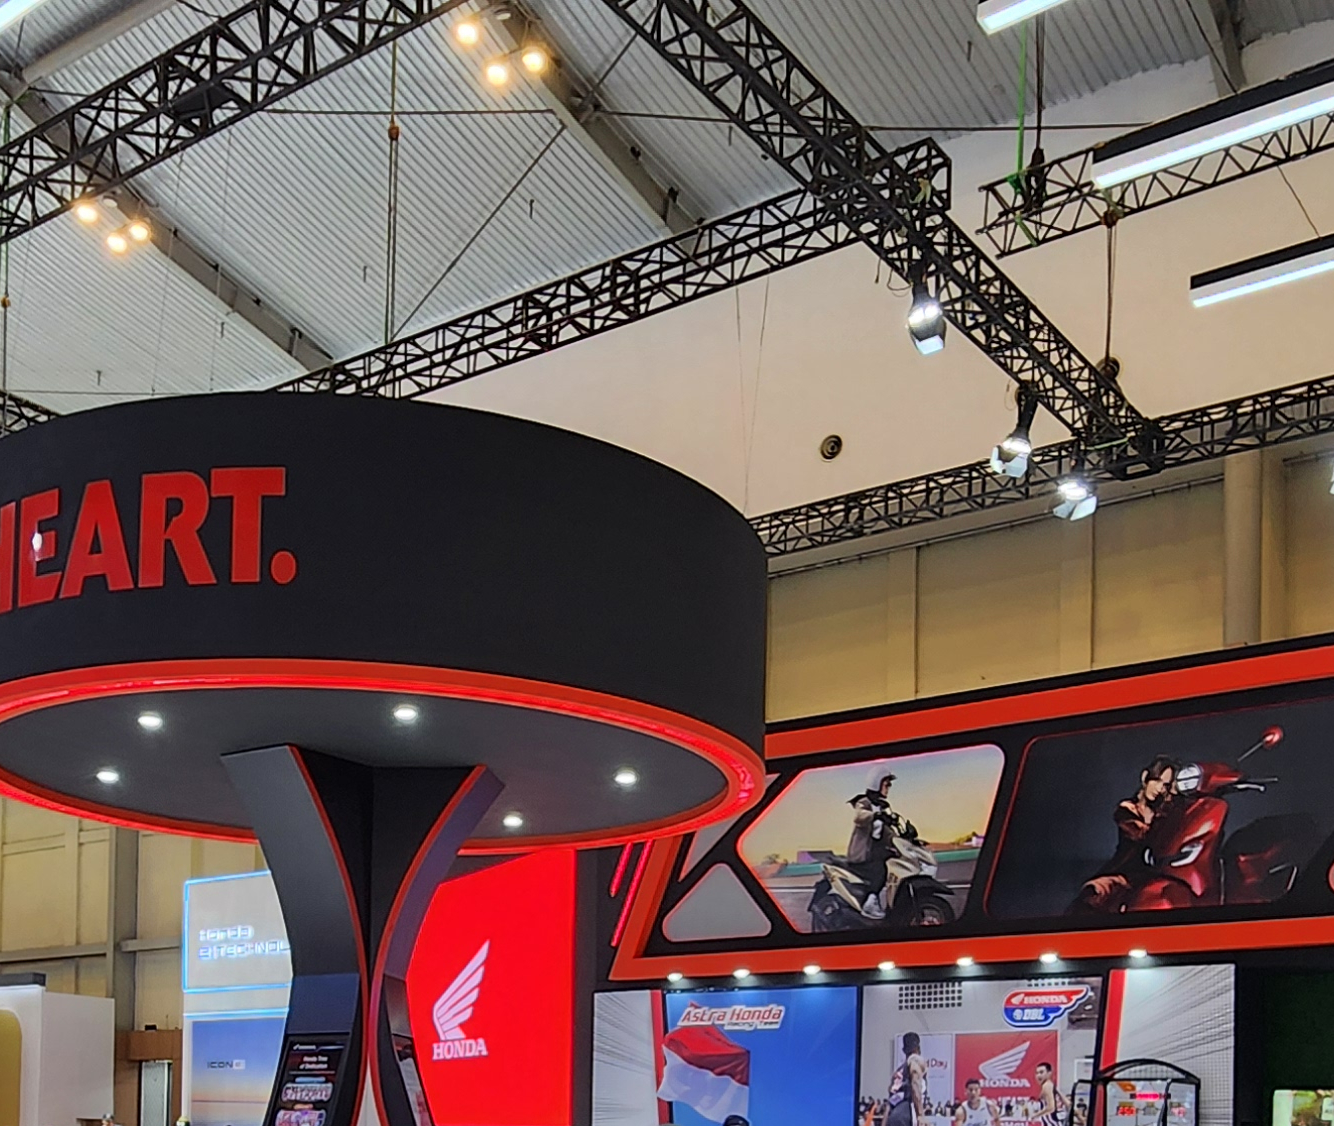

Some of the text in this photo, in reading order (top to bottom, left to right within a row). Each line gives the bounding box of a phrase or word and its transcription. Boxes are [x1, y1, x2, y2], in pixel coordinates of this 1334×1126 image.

[1024, 995, 1068, 1004] HONDA
[681, 1006, 783, 1022] Astra Honda
[432, 1037, 489, 1061] HONDA
[207, 1061, 233, 1069] ICON
[978, 1078, 1031, 1088] HONDA
